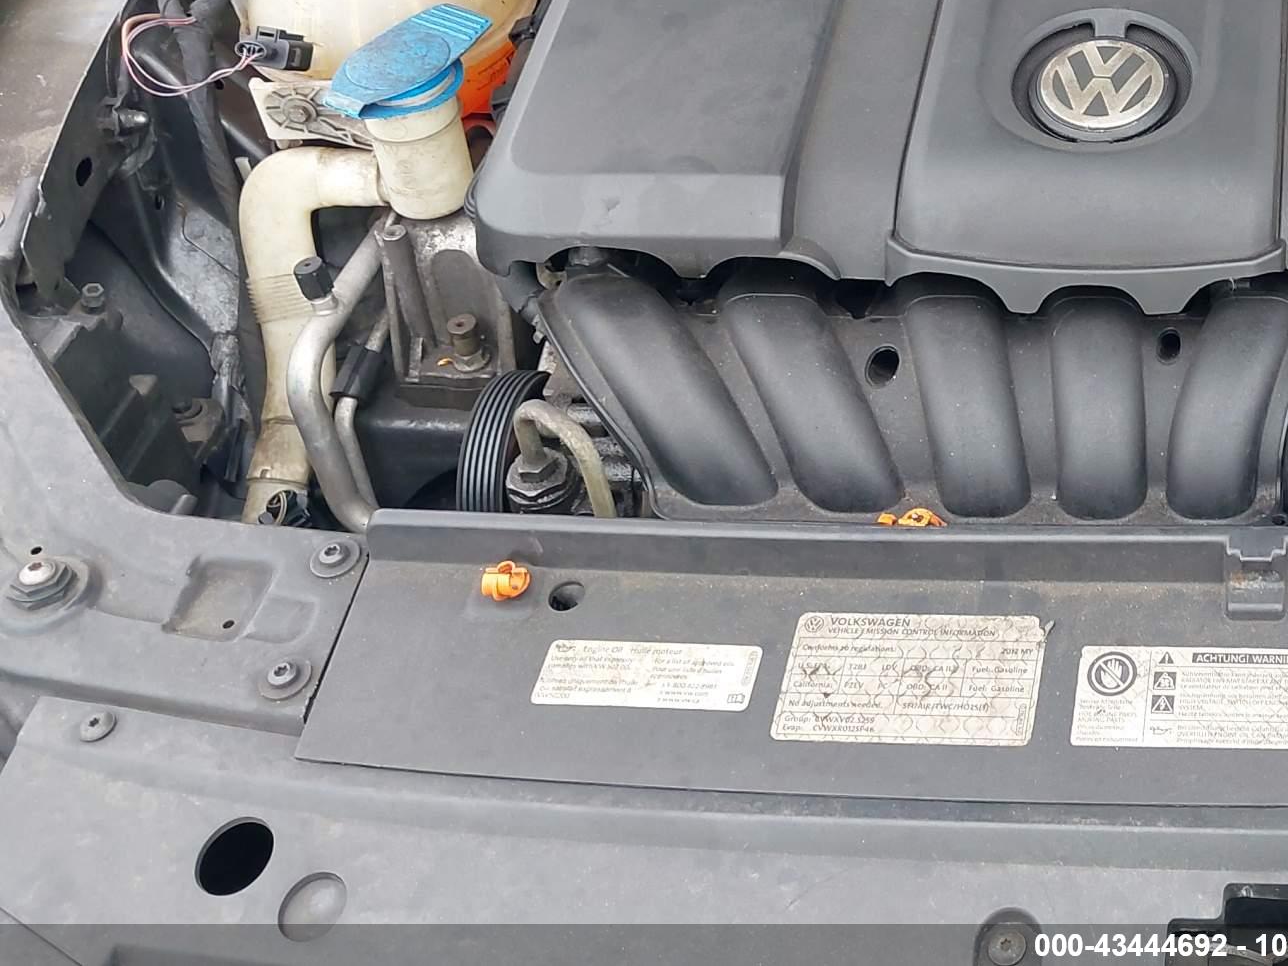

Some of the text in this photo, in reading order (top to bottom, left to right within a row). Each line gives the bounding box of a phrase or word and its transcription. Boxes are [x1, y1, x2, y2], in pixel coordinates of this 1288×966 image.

[831, 617, 910, 626] VOLKSWAGEN
[828, 627, 859, 635] VEHICLE
[901, 628, 936, 636] CONTROL
[1197, 653, 1249, 664] ACHTUNG!
[994, 666, 1028, 675] Gasoline
[793, 680, 834, 689] California:
[990, 685, 1025, 694] Gasoline
[789, 699, 800, 707] No
[802, 699, 850, 710] adjustments
